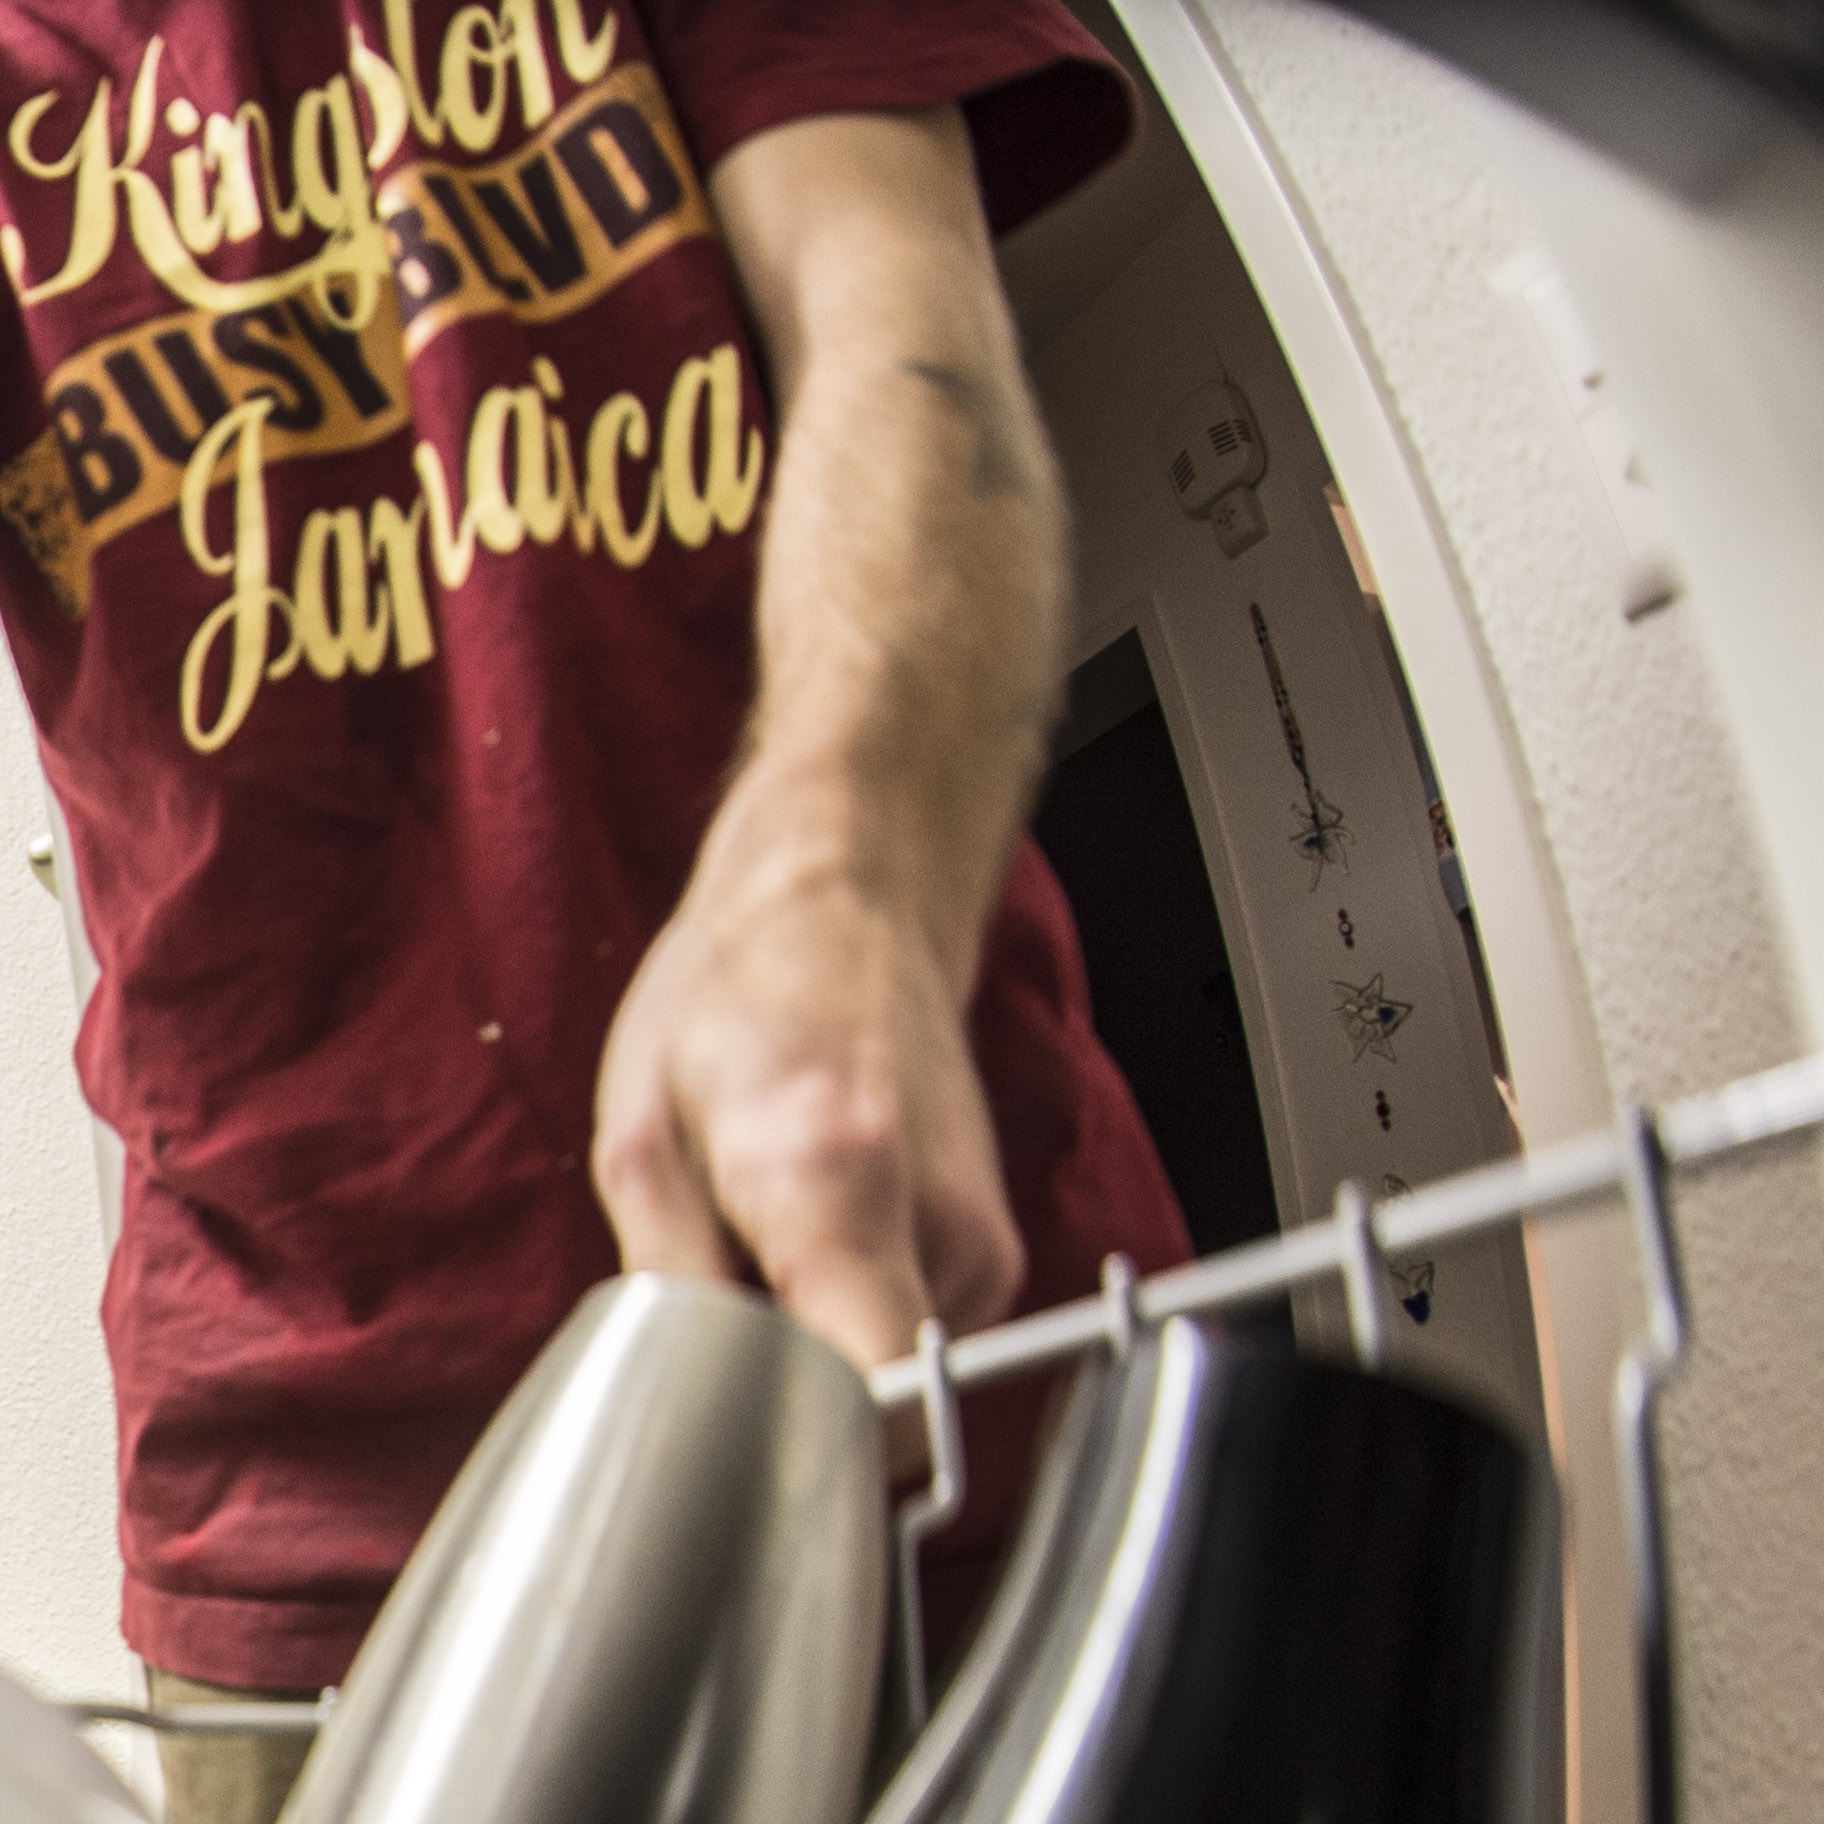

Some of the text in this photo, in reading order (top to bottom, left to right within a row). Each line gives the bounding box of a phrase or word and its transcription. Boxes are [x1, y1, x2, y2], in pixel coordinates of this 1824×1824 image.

[50, 98, 683, 525] BUSY BLVD
[179, 343, 764, 754] Jamaica
